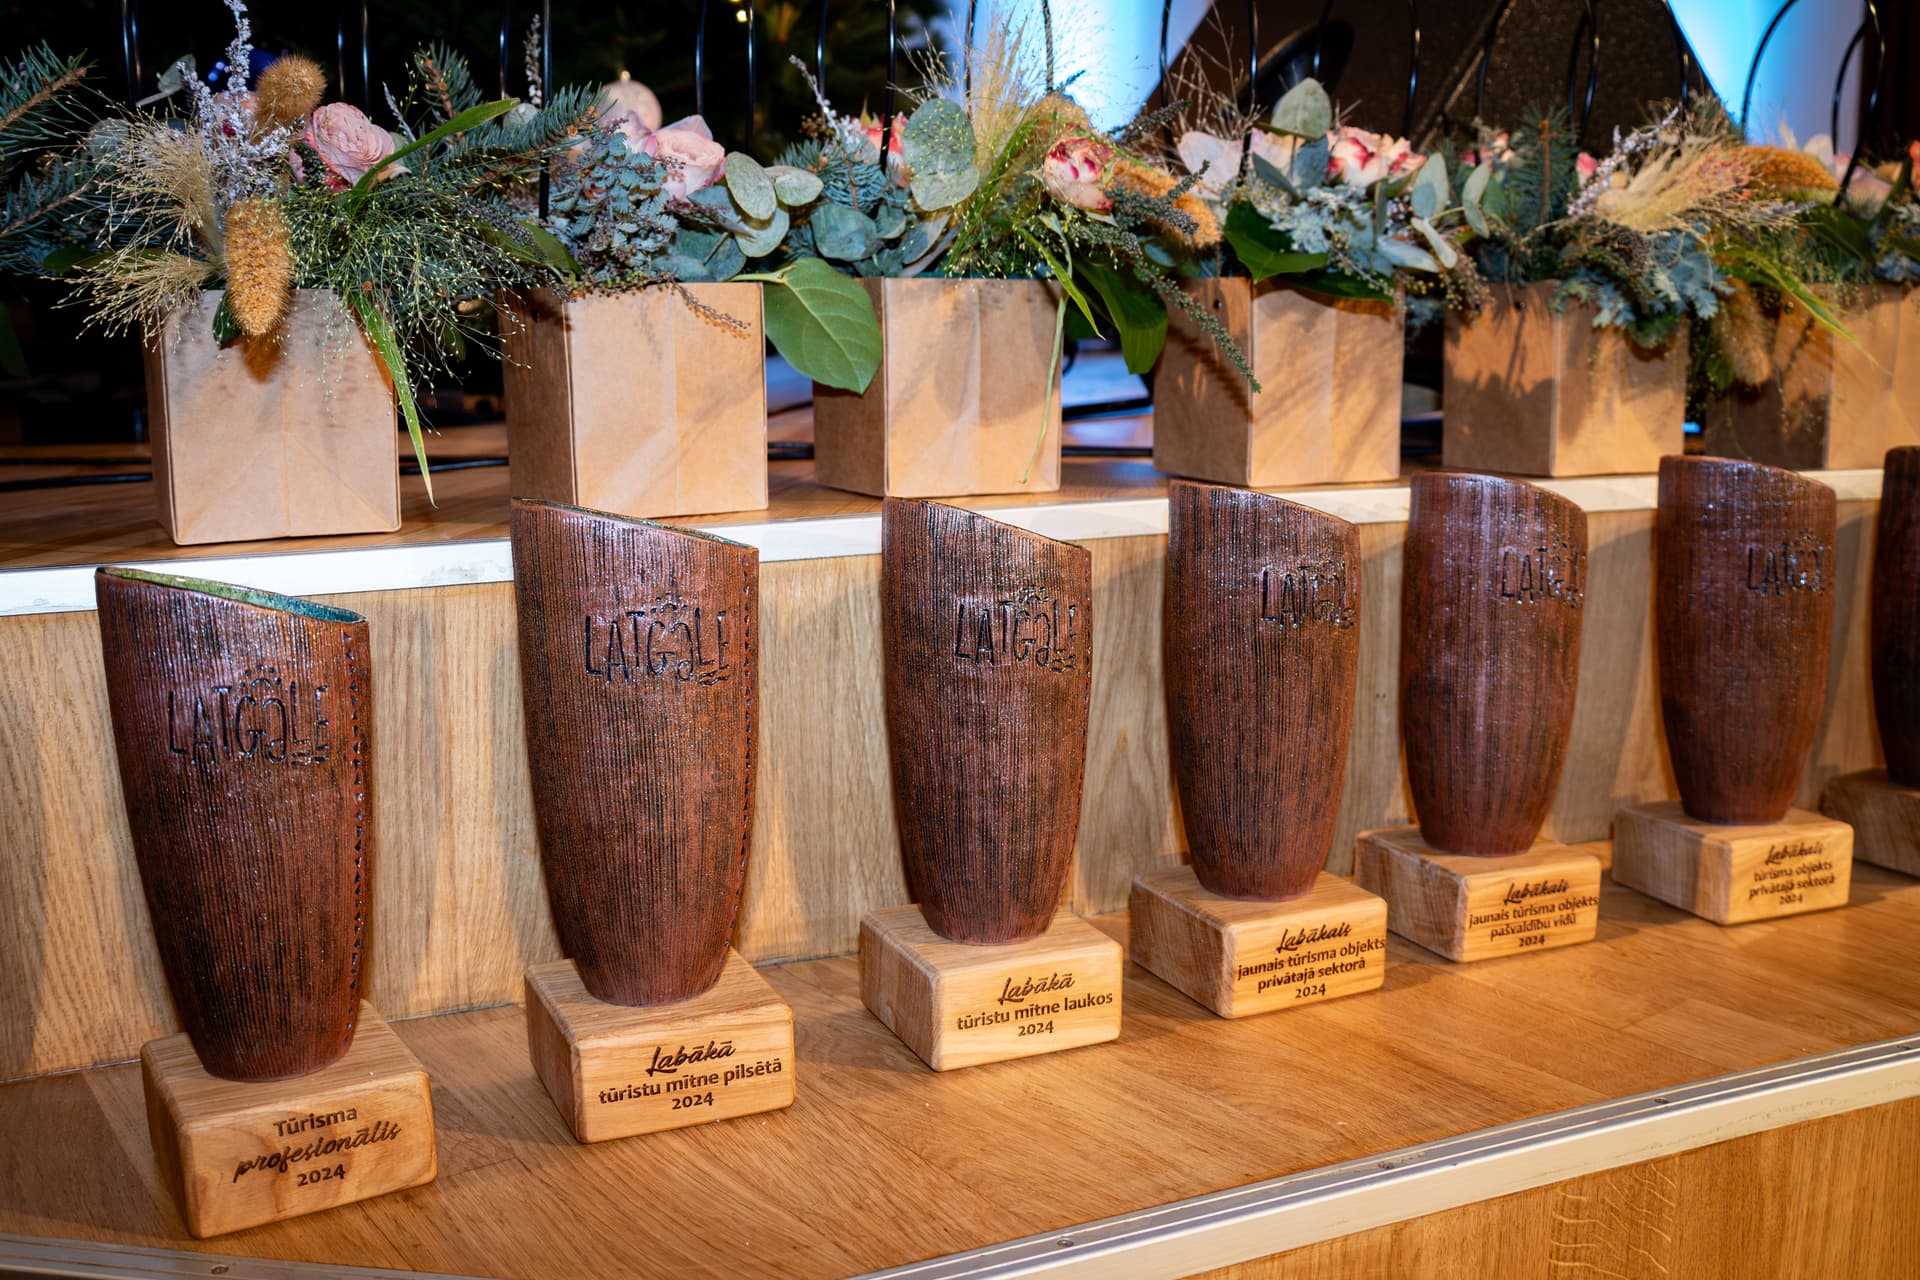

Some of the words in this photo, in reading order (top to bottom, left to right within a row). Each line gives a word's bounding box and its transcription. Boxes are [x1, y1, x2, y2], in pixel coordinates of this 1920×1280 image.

[1503, 880, 1569, 905] Labākais
[1779, 893, 1803, 905] 2024
[1469, 909, 1510, 928] jaunais
[1512, 904, 1555, 919] tūrisma
[1558, 895, 1600, 912] objekts
[1490, 918, 1551, 941] pašvaldību
[1553, 912, 1577, 927] vidū
[1276, 922, 1352, 953] Labākais
[1519, 935, 1546, 947] 2024
[1237, 957, 1284, 981] jaunais
[1287, 949, 1337, 968] tūrisma
[1339, 938, 1386, 957] objekts
[997, 972, 1075, 1006] Labākā
[1258, 967, 1315, 993] privātajā
[1318, 957, 1366, 978] sektorā
[1295, 983, 1326, 999] 2024
[956, 1011, 1010, 1030] tūristu
[1014, 1002, 1060, 1020] mītne
[1064, 992, 1113, 1011] laukos
[1017, 1020, 1055, 1037] 2024
[645, 1040, 737, 1077] Labākā
[598, 1082, 661, 1104] tūristu
[665, 1074, 719, 1093] mītne
[723, 1058, 782, 1086] pilsētā
[671, 1092, 714, 1110] 2024
[273, 1107, 358, 1137] Tūrisma
[233, 1120, 403, 1183] profesionālis
[296, 1163, 346, 1187] 2024
